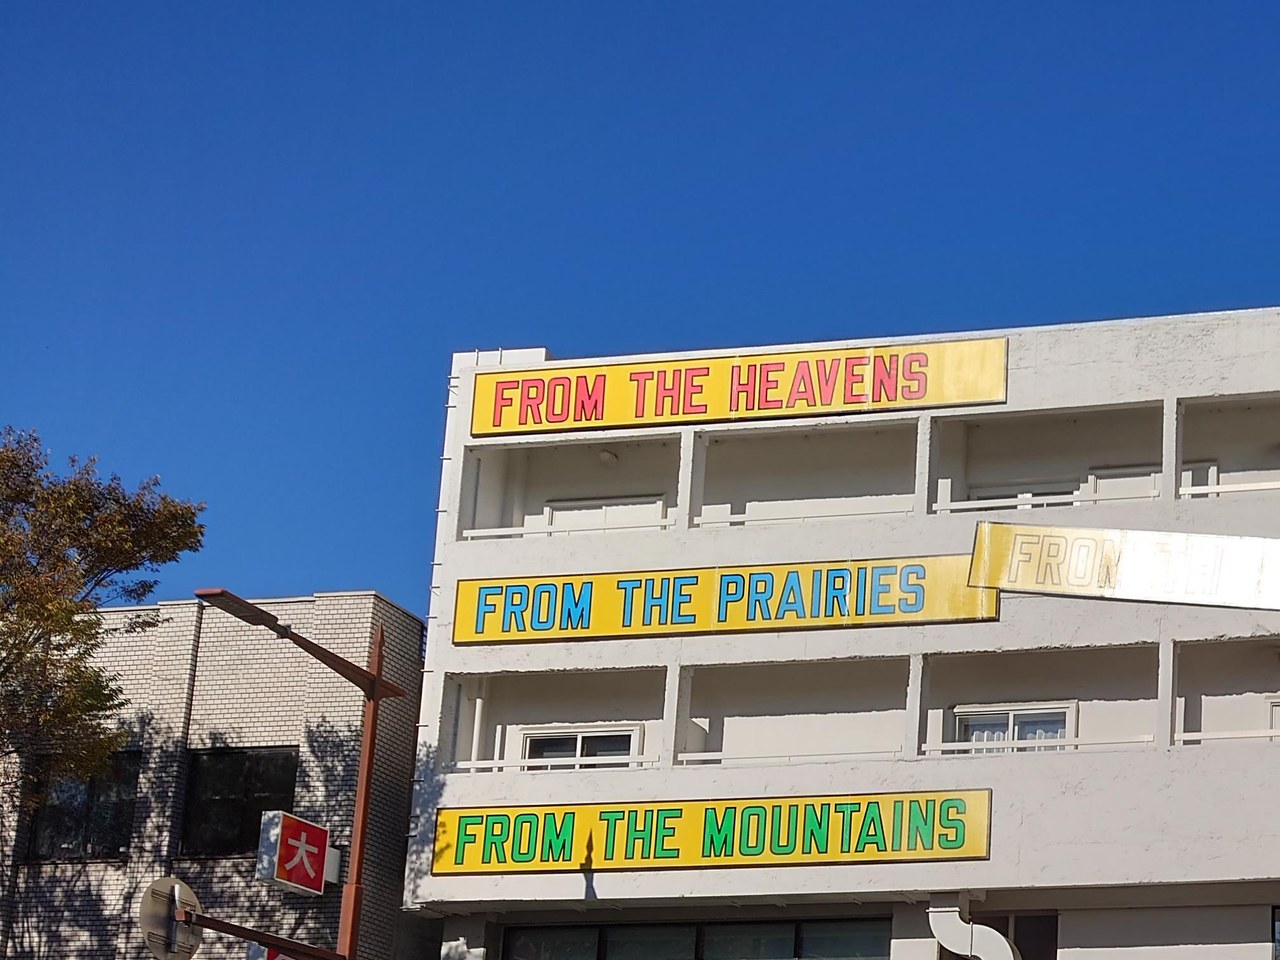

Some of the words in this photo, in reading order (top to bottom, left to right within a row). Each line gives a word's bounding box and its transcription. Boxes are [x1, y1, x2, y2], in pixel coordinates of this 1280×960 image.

[492, 374, 606, 427] FROM
[629, 367, 709, 418] THE
[730, 352, 928, 412] HEAVENS
[475, 581, 593, 634] FROM
[616, 576, 699, 627] THE
[717, 564, 927, 623] PRAIRIES
[454, 811, 575, 866] FROM
[599, 808, 683, 861] THE
[702, 798, 967, 859] MOUNTAINS
